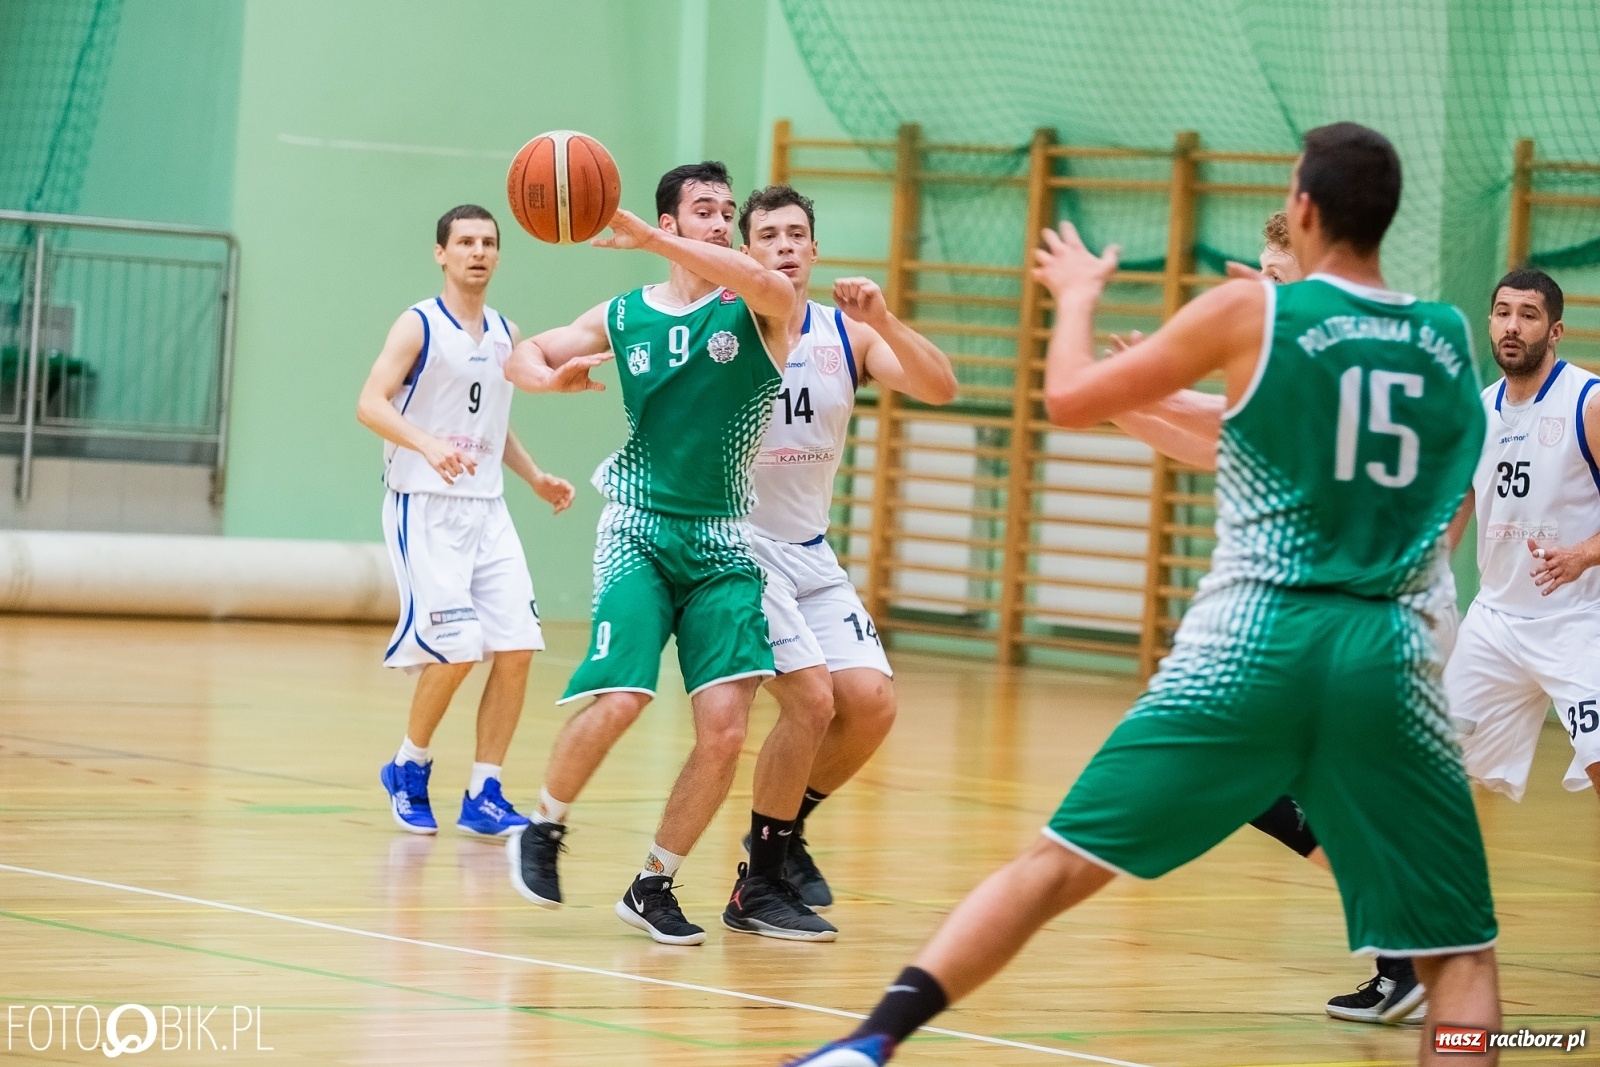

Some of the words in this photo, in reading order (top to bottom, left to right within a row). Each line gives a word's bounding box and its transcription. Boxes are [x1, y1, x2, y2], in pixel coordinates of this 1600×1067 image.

[668, 325, 690, 368] 9
[468, 382, 481, 414] 9
[777, 387, 814, 425] 14
[1335, 366, 1424, 488] 15
[780, 452, 829, 463] KAMPKA
[1497, 461, 1531, 498] 35
[1495, 529, 1546, 538] KAMPKA
[591, 621, 612, 661] 9
[843, 612, 880, 646] 14
[1568, 699, 1600, 741] 35
